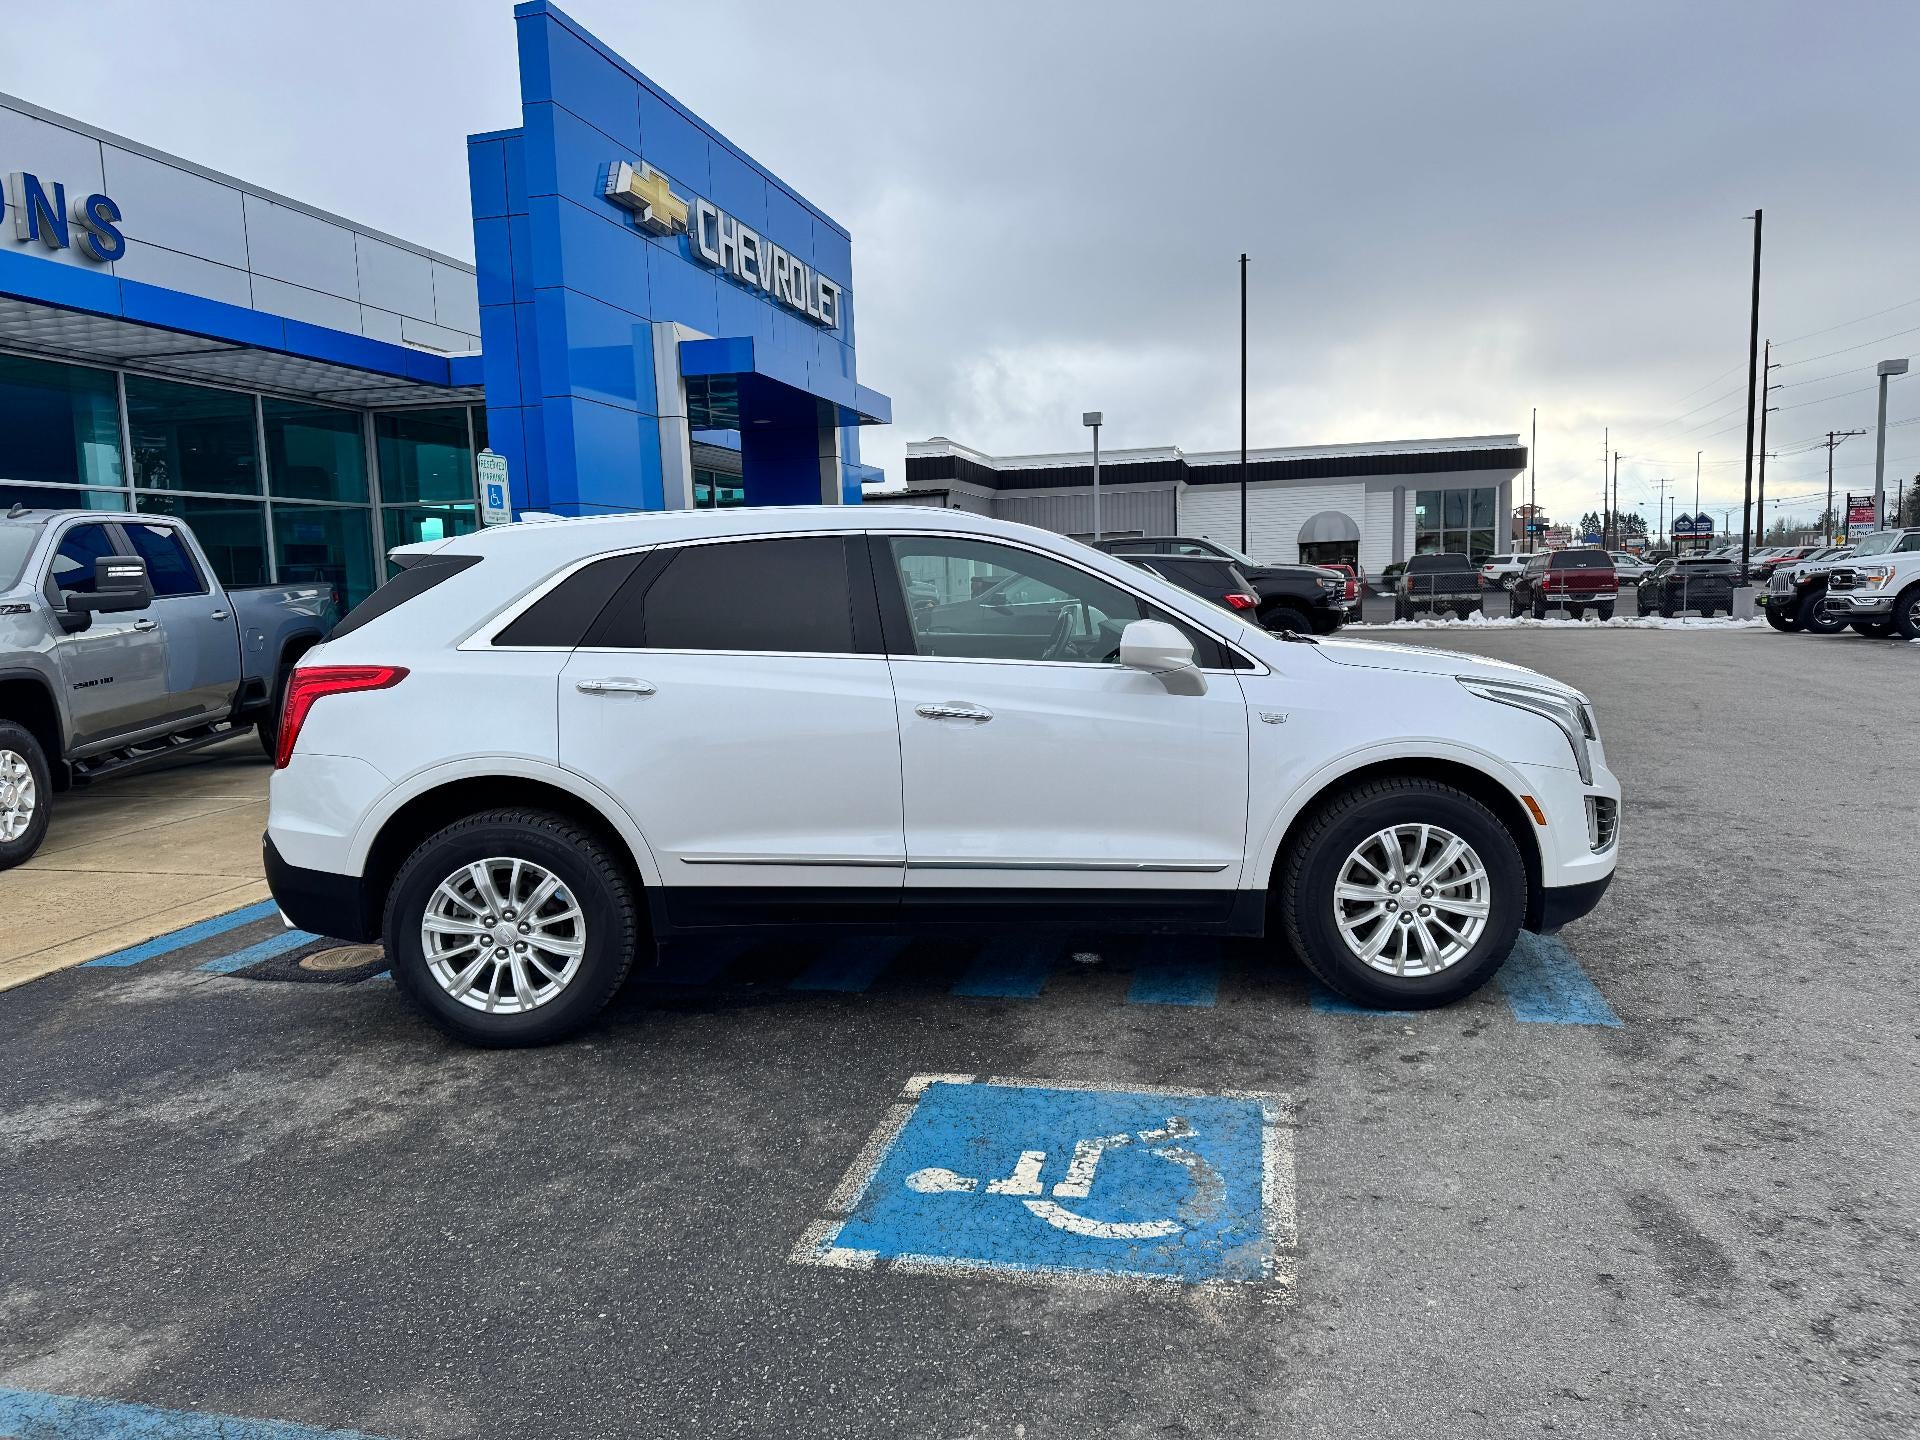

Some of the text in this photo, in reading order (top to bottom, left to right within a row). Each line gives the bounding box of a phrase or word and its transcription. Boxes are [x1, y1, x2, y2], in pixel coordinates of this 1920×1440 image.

[0, 172, 125, 261] NS
[688, 197, 842, 330] CHEVROLET
[480, 459, 505, 471] RESERVED
[482, 471, 505, 483] PARKING
